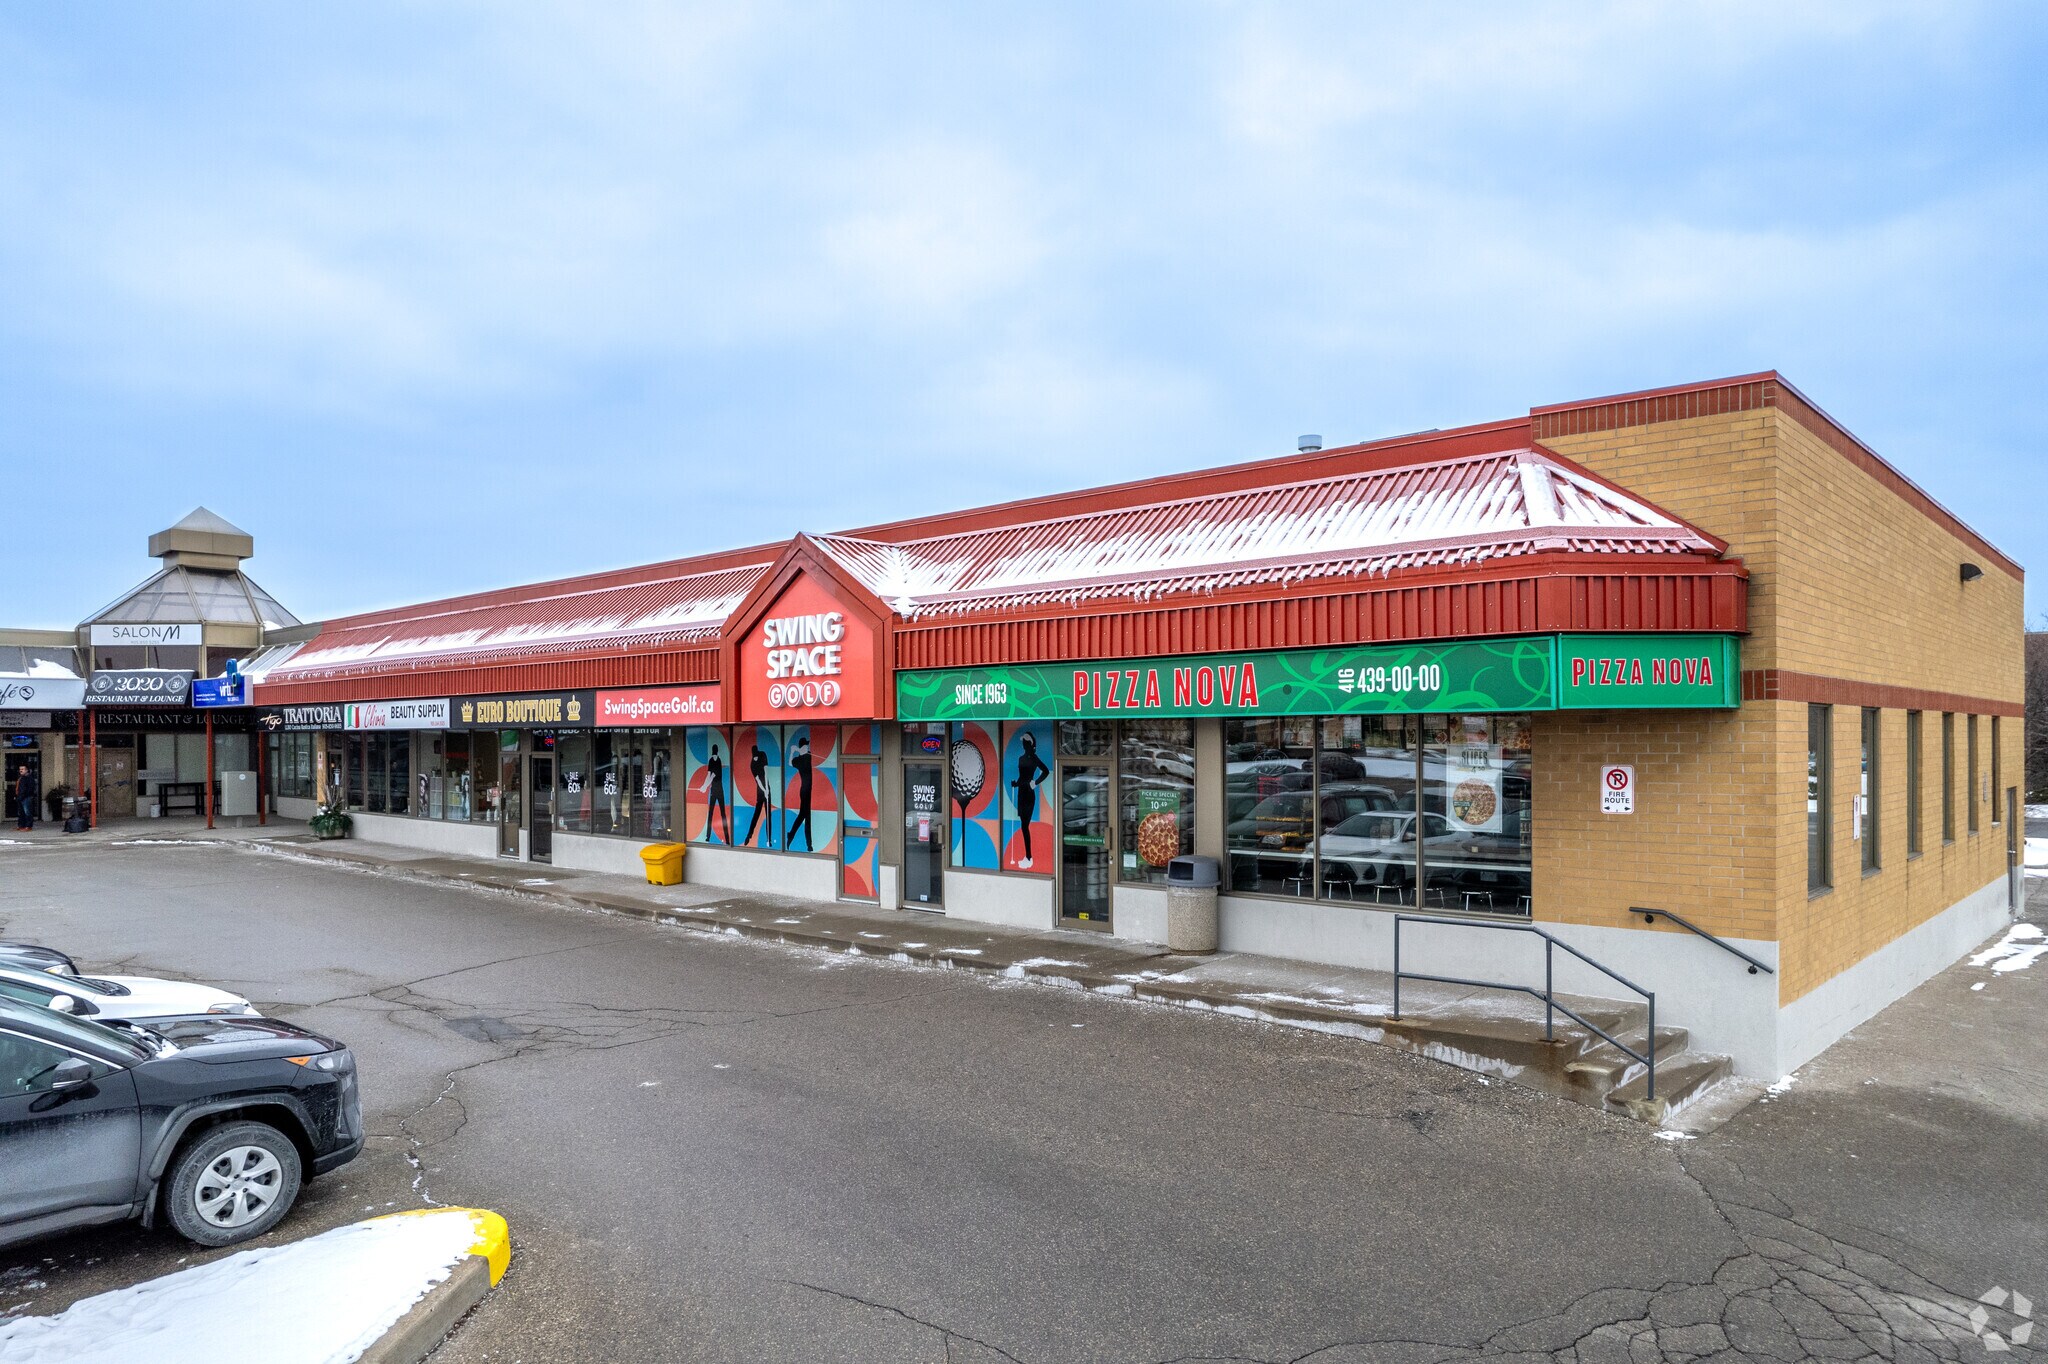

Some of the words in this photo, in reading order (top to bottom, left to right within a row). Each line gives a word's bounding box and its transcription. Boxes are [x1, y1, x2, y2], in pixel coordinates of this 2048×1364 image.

[112, 626, 161, 638] SALON
[162, 624, 180, 643] M
[763, 611, 845, 648] SWING
[766, 645, 842, 679] SPACE
[1337, 668, 1355, 694] 416
[1356, 663, 1441, 694] 439-00-00
[1571, 655, 1643, 687] PIZZA
[1652, 655, 1714, 687] NOVA
[114, 676, 164, 692] 2020
[1072, 668, 1161, 712] PIZZA
[1173, 661, 1260, 708] NOVA
[85, 695, 138, 703] RESTAURANT
[139, 695, 149, 703] &
[149, 695, 185, 703] LOUNGE
[769, 681, 838, 707] GOLF
[955, 684, 983, 705] SINCE
[985, 682, 1008, 704] 1963
[390, 705, 416, 719] BEAUTY
[417, 704, 445, 718] SUPPLY
[477, 700, 504, 723] EURO
[506, 698, 562, 724] BOUTIQUE
[604, 694, 715, 719] SwingSpaceGolf.ca
[98, 713, 181, 724] RESTAURANT
[921, 740, 941, 749] OPEN
[1461, 750, 1488, 765] SLICES
[569, 772, 579, 781] SALE
[605, 773, 616, 782] SALE
[912, 784, 936, 794] SWING
[913, 793, 935, 803] SPACE
